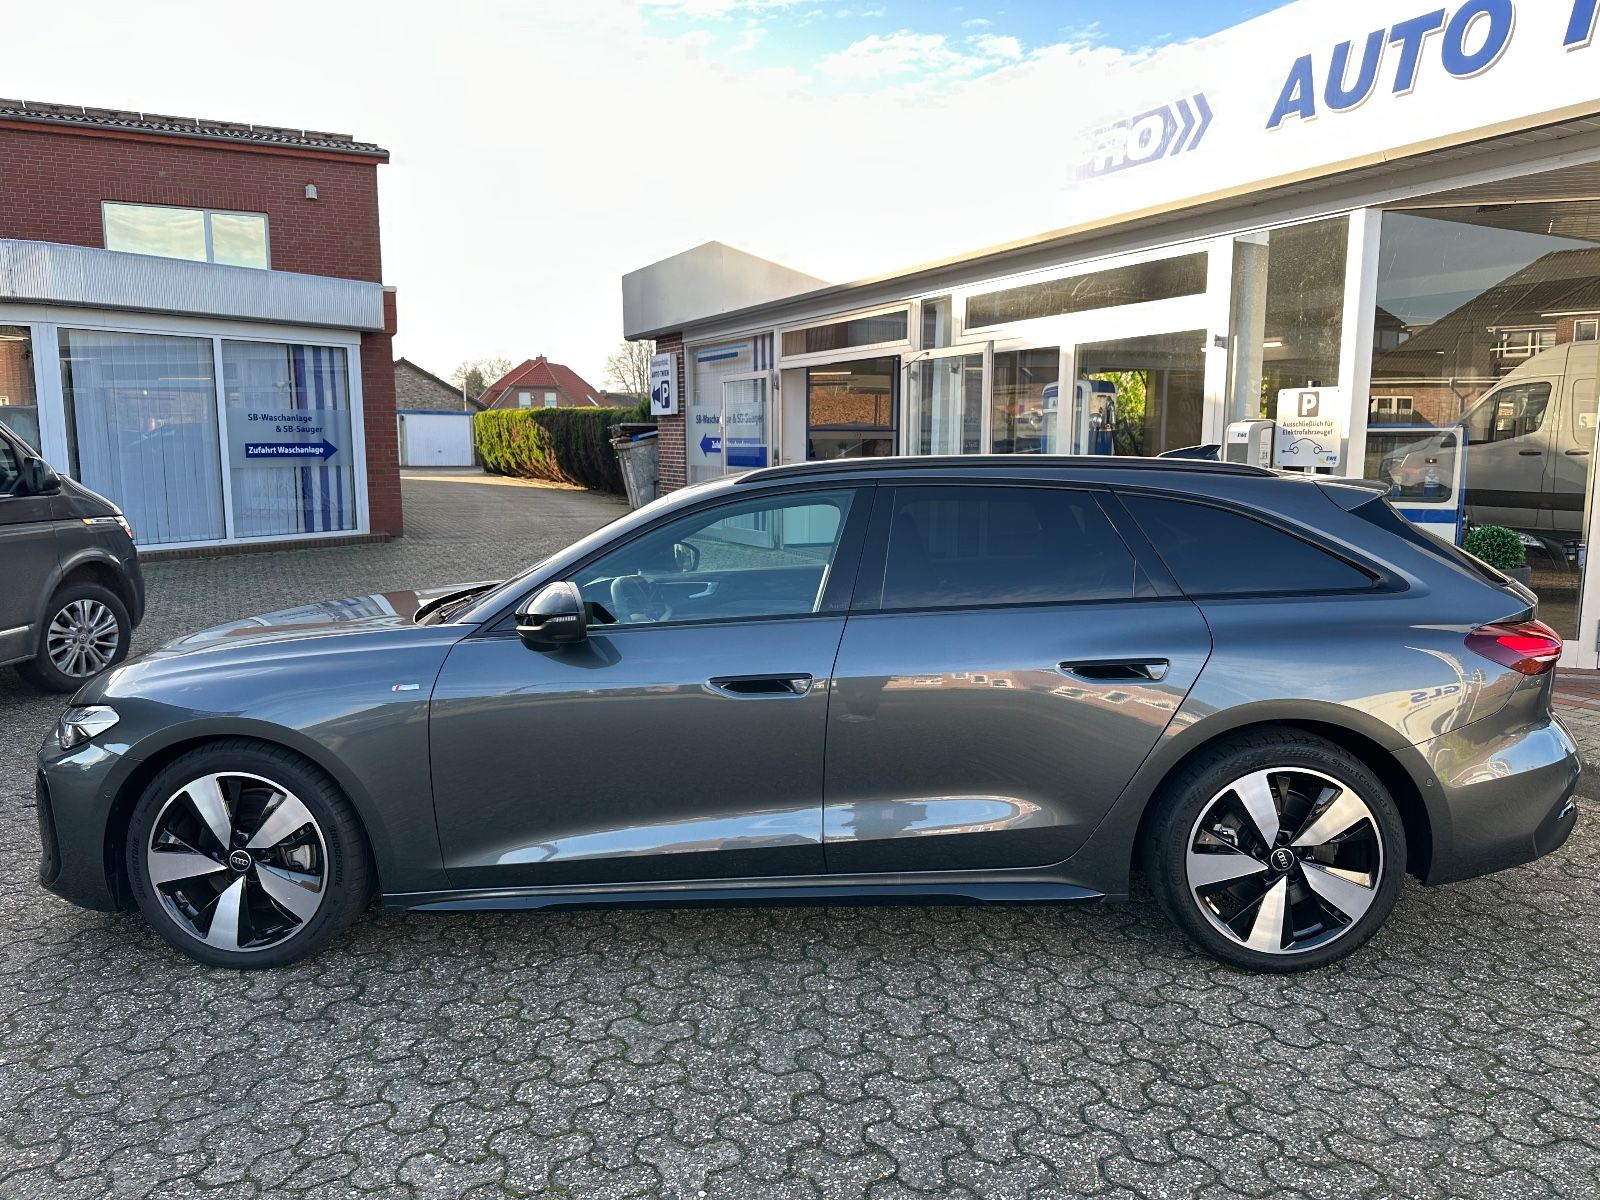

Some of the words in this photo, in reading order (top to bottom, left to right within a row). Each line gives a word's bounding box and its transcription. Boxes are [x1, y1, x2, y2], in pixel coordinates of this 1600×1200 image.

[1265, 0, 1515, 131] AUTO
[1301, 393, 1317, 416] P
[247, 413, 313, 424] SB-Waschanlage
[1282, 420, 1324, 428] Ausschließlich
[275, 425, 282, 433] &
[283, 425, 323, 435] SB-Sauger
[248, 446, 276, 454] Zufahrt
[277, 446, 324, 455] Waschanlage
